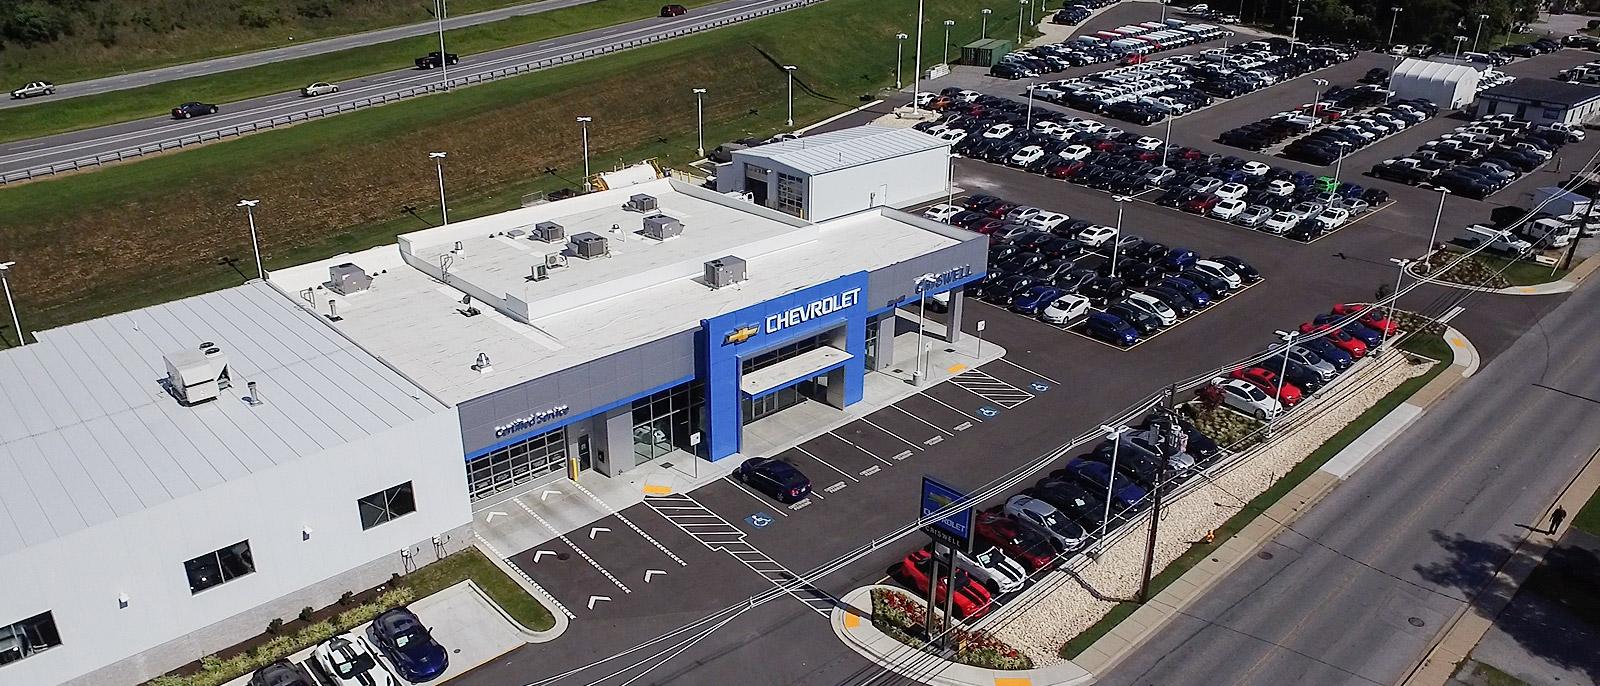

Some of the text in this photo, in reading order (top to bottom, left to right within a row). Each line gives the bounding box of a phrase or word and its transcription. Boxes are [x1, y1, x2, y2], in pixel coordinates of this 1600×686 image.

[765, 288, 862, 334] CHEVROLET
[494, 405, 569, 438] Certified Service
[925, 526, 961, 547] CRISWELL
